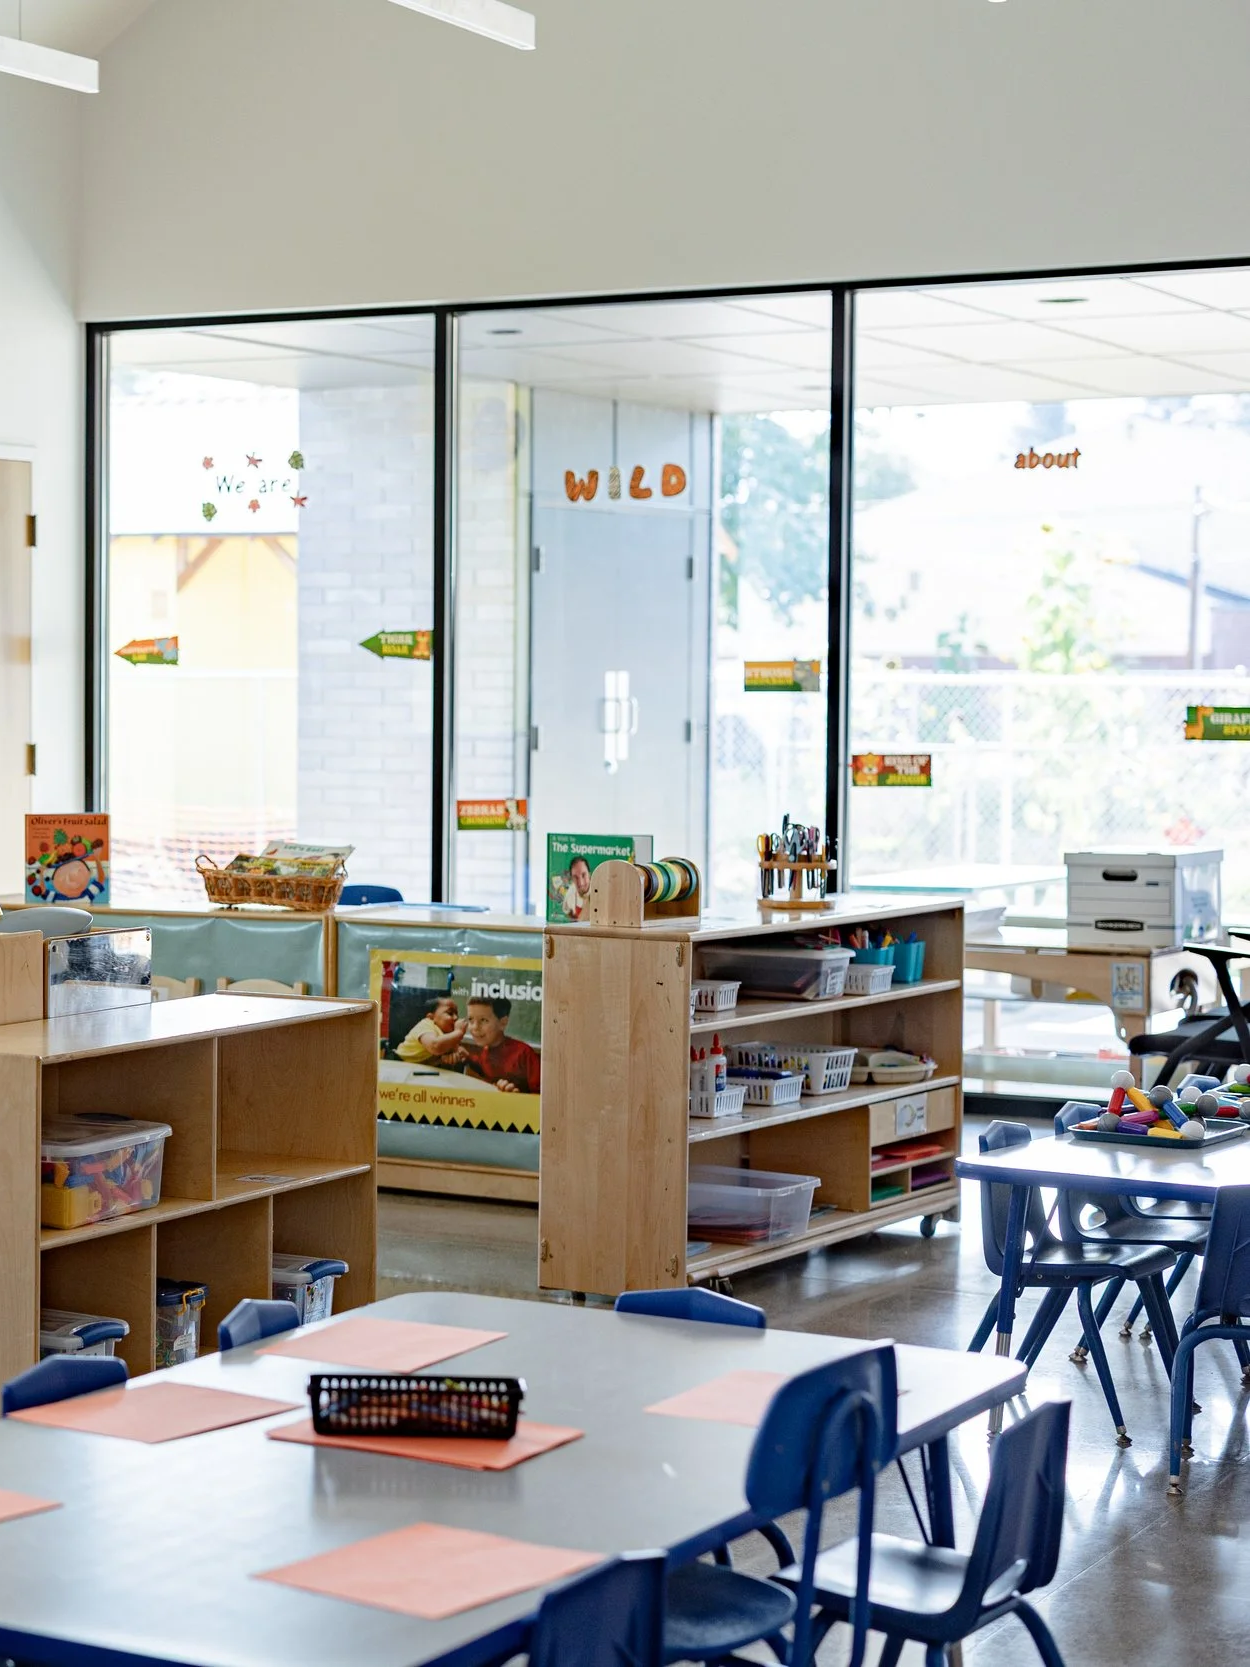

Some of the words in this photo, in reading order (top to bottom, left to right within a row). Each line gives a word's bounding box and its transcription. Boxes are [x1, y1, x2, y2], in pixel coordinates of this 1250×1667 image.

[1014, 446, 1081, 469] about
[216, 474, 246, 494] We
[258, 478, 291, 494] are
[565, 463, 687, 502] WILD
[31, 816, 62, 826] Oliver's
[63, 816, 83, 826] Fruit
[85, 816, 107, 826] Salad
[552, 842, 568, 853] The
[571, 842, 631, 857] Supermarket
[452, 986, 469, 997] with
[471, 976, 543, 1002] inclusio
[379, 1087, 411, 1102] we're
[413, 1089, 427, 1104] all
[430, 1091, 475, 1108] winners
